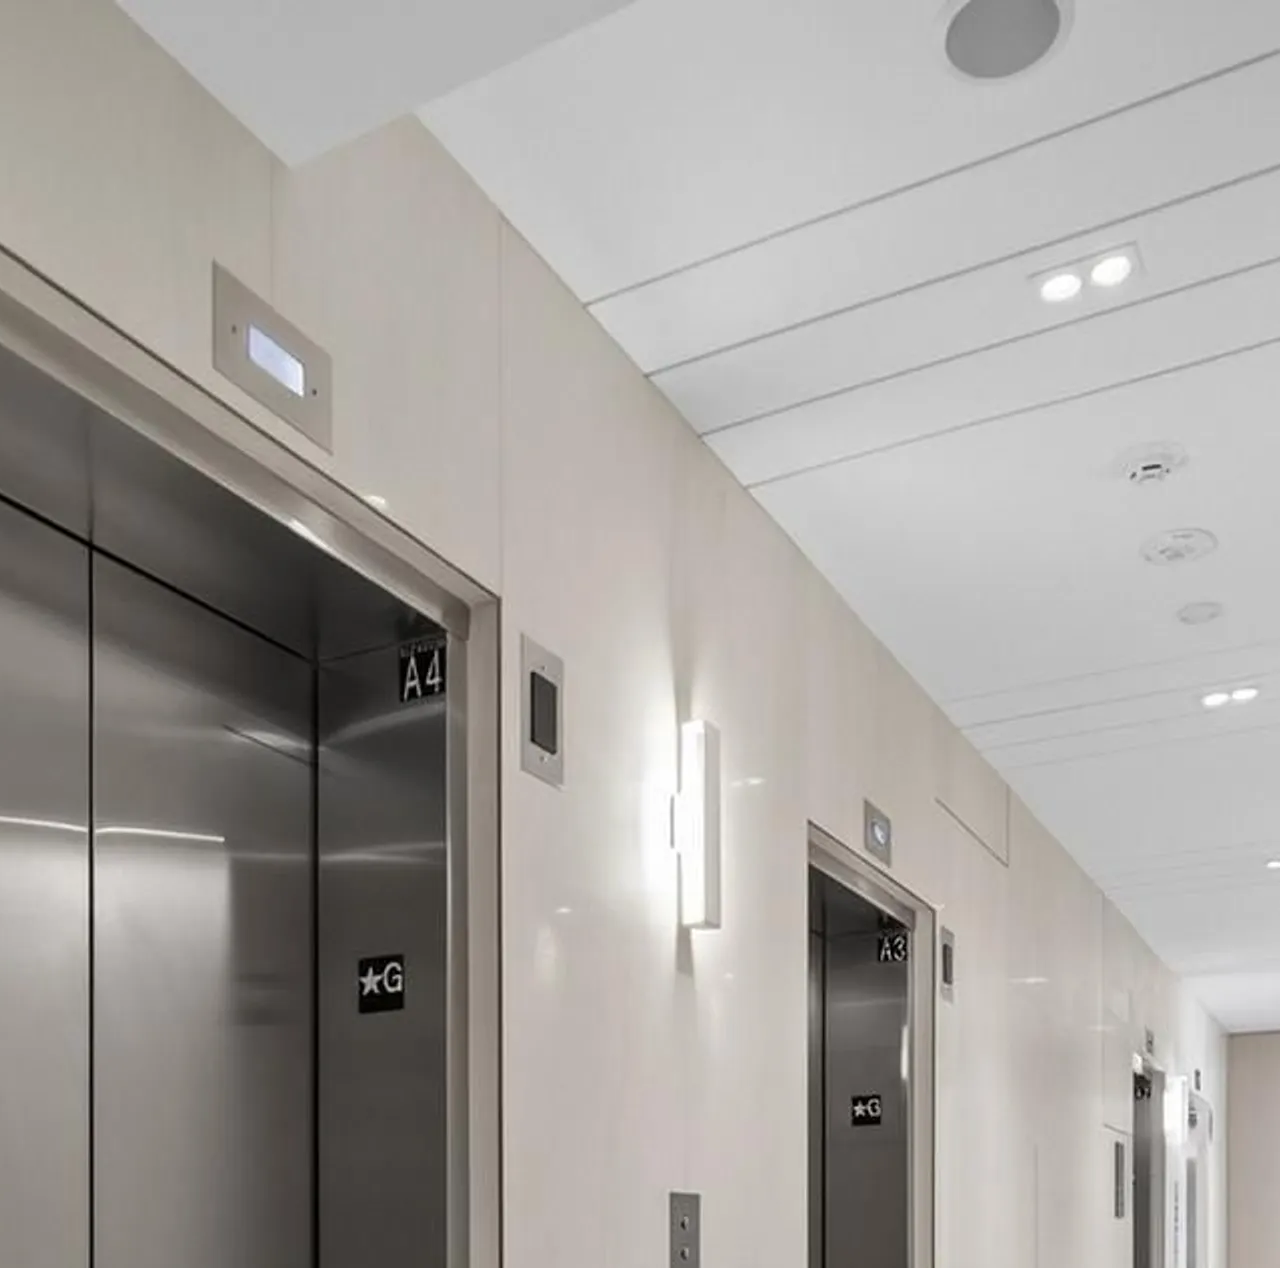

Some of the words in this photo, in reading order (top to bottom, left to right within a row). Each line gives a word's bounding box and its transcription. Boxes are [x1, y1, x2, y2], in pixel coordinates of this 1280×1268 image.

[404, 649, 443, 701] A4
[880, 936, 906, 961] A3
[383, 961, 402, 993] G
